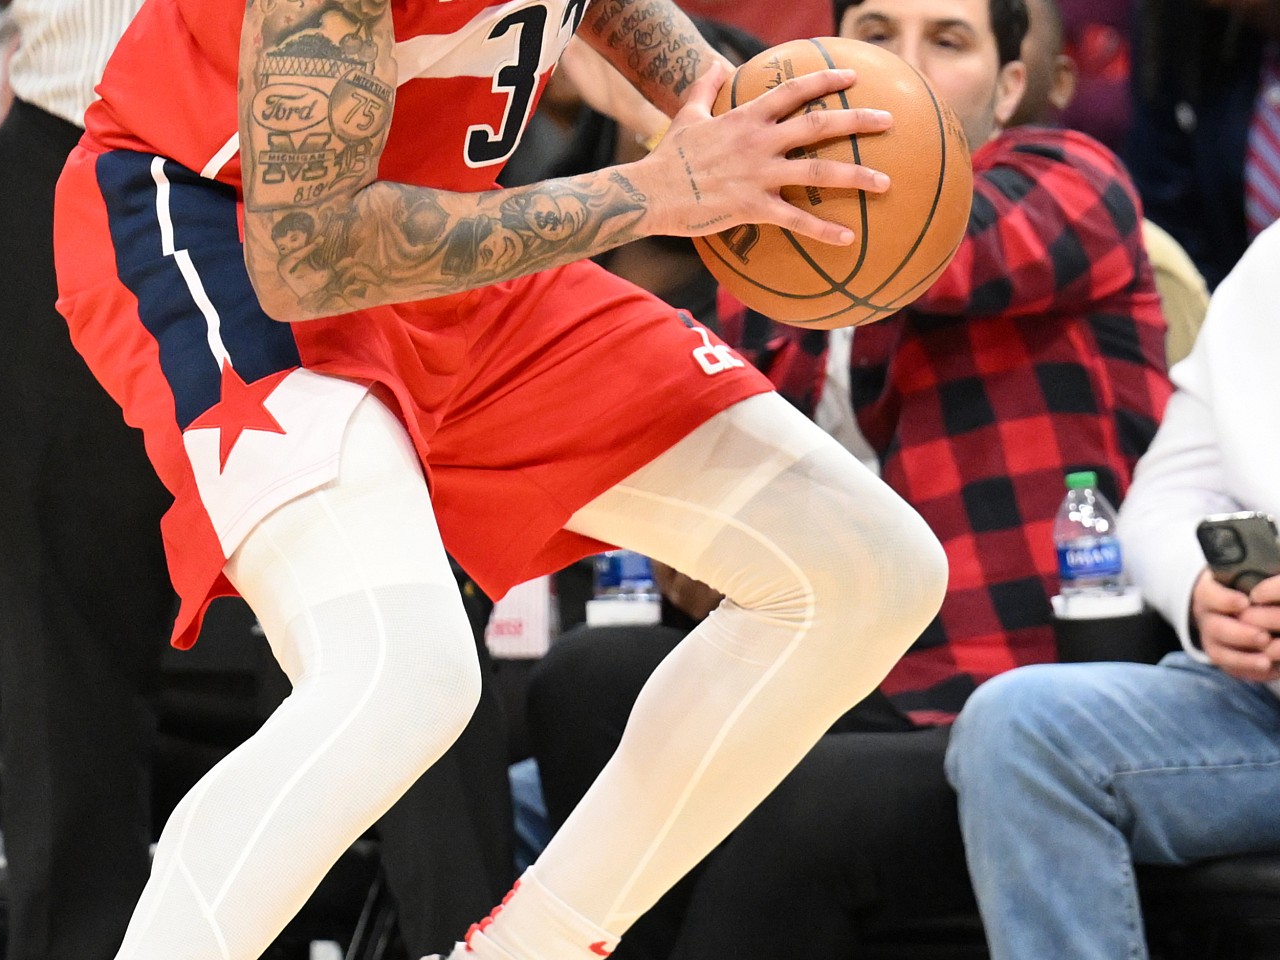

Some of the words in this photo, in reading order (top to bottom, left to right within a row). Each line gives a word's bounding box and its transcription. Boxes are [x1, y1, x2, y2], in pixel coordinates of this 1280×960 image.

[261, 93, 318, 121] Ford
[344, 92, 380, 131] 75
[268, 152, 326, 162] MICHIGAN
